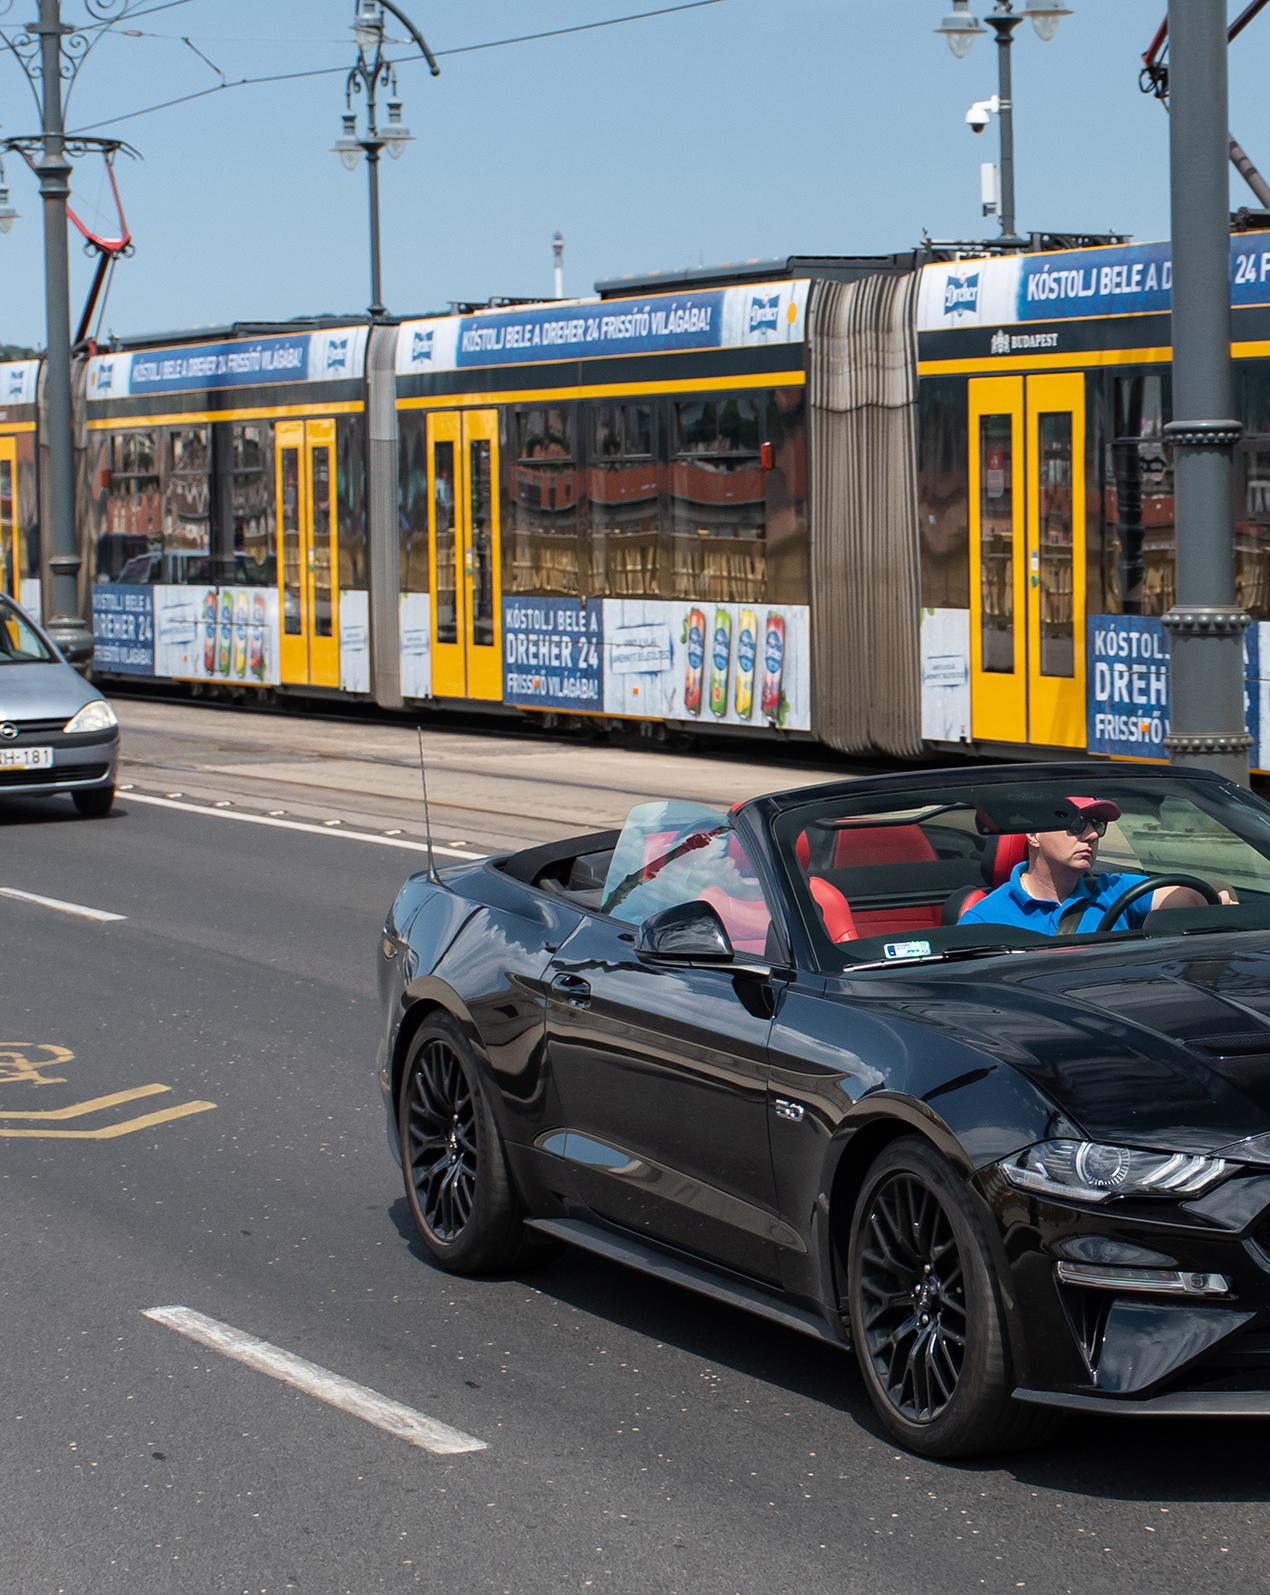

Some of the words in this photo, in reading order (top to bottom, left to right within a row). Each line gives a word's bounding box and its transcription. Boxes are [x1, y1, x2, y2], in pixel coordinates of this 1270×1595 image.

[1027, 264, 1097, 301] KÓSTOLJ
[1100, 264, 1144, 295] BELE
[1145, 263, 1158, 291] A
[1235, 253, 1257, 284] 24
[461, 323, 504, 352] KÓSTOLJ
[505, 324, 533, 349] BELE
[532, 324, 541, 346] A
[542, 318, 586, 345] DREHER
[586, 318, 600, 342] 24
[600, 305, 651, 340] FRISSÍTŐ
[651, 302, 712, 336] VILÁGÁBA!
[1011, 333, 1059, 349] BUDAPEST
[505, 603, 554, 630] KÓSTOLJ
[557, 609, 587, 633] BELE
[589, 611, 598, 633] A
[505, 633, 573, 668] DREHER
[578, 636, 598, 669] 24
[1095, 624, 1170, 659] KÓSTOL
[549, 671, 598, 700] VILÁGÁBA!
[1095, 661, 1166, 705] DREH
[1095, 709, 1162, 744] FRISSÍTŐ
